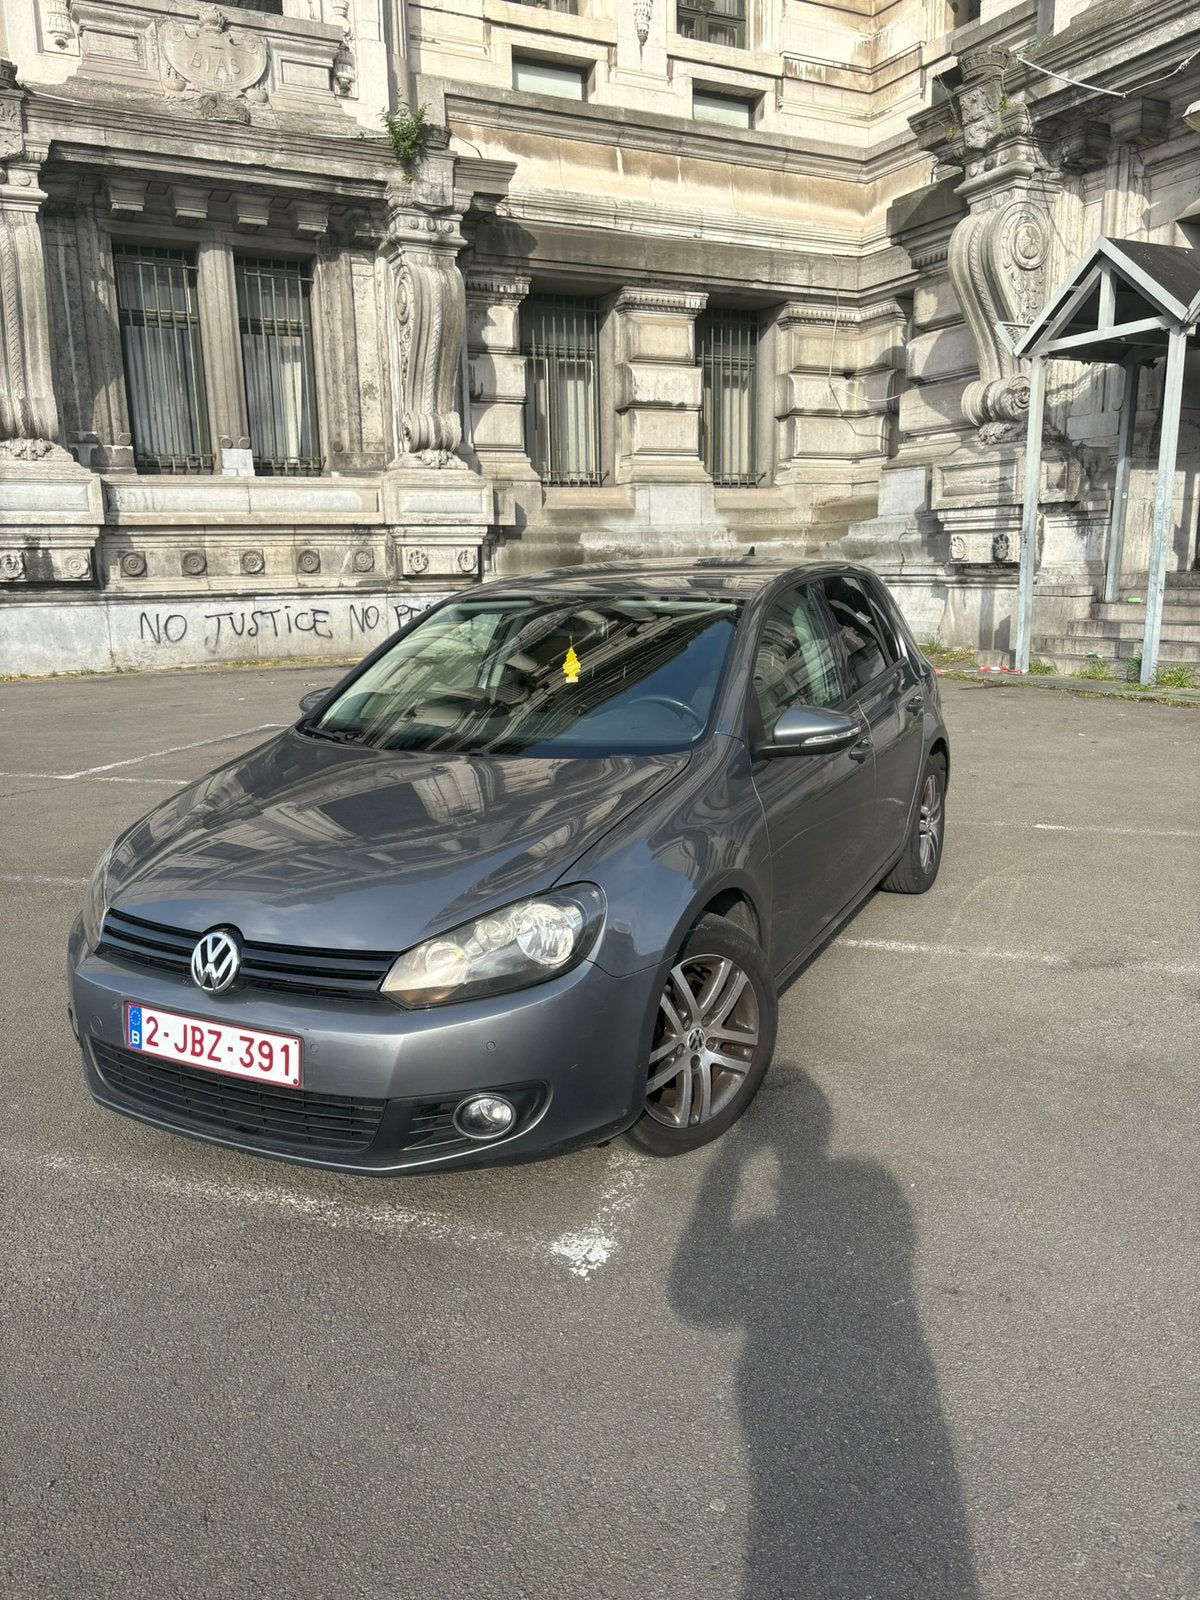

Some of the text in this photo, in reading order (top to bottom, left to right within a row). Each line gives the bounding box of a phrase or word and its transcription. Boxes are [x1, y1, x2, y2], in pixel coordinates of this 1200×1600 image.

[190, 51, 241, 75] BIAS
[140, 612, 188, 644] NO
[349, 604, 379, 642] NO
[191, 932, 240, 994] VW
[131, 1016, 290, 1077] B 2-JBZ-391
